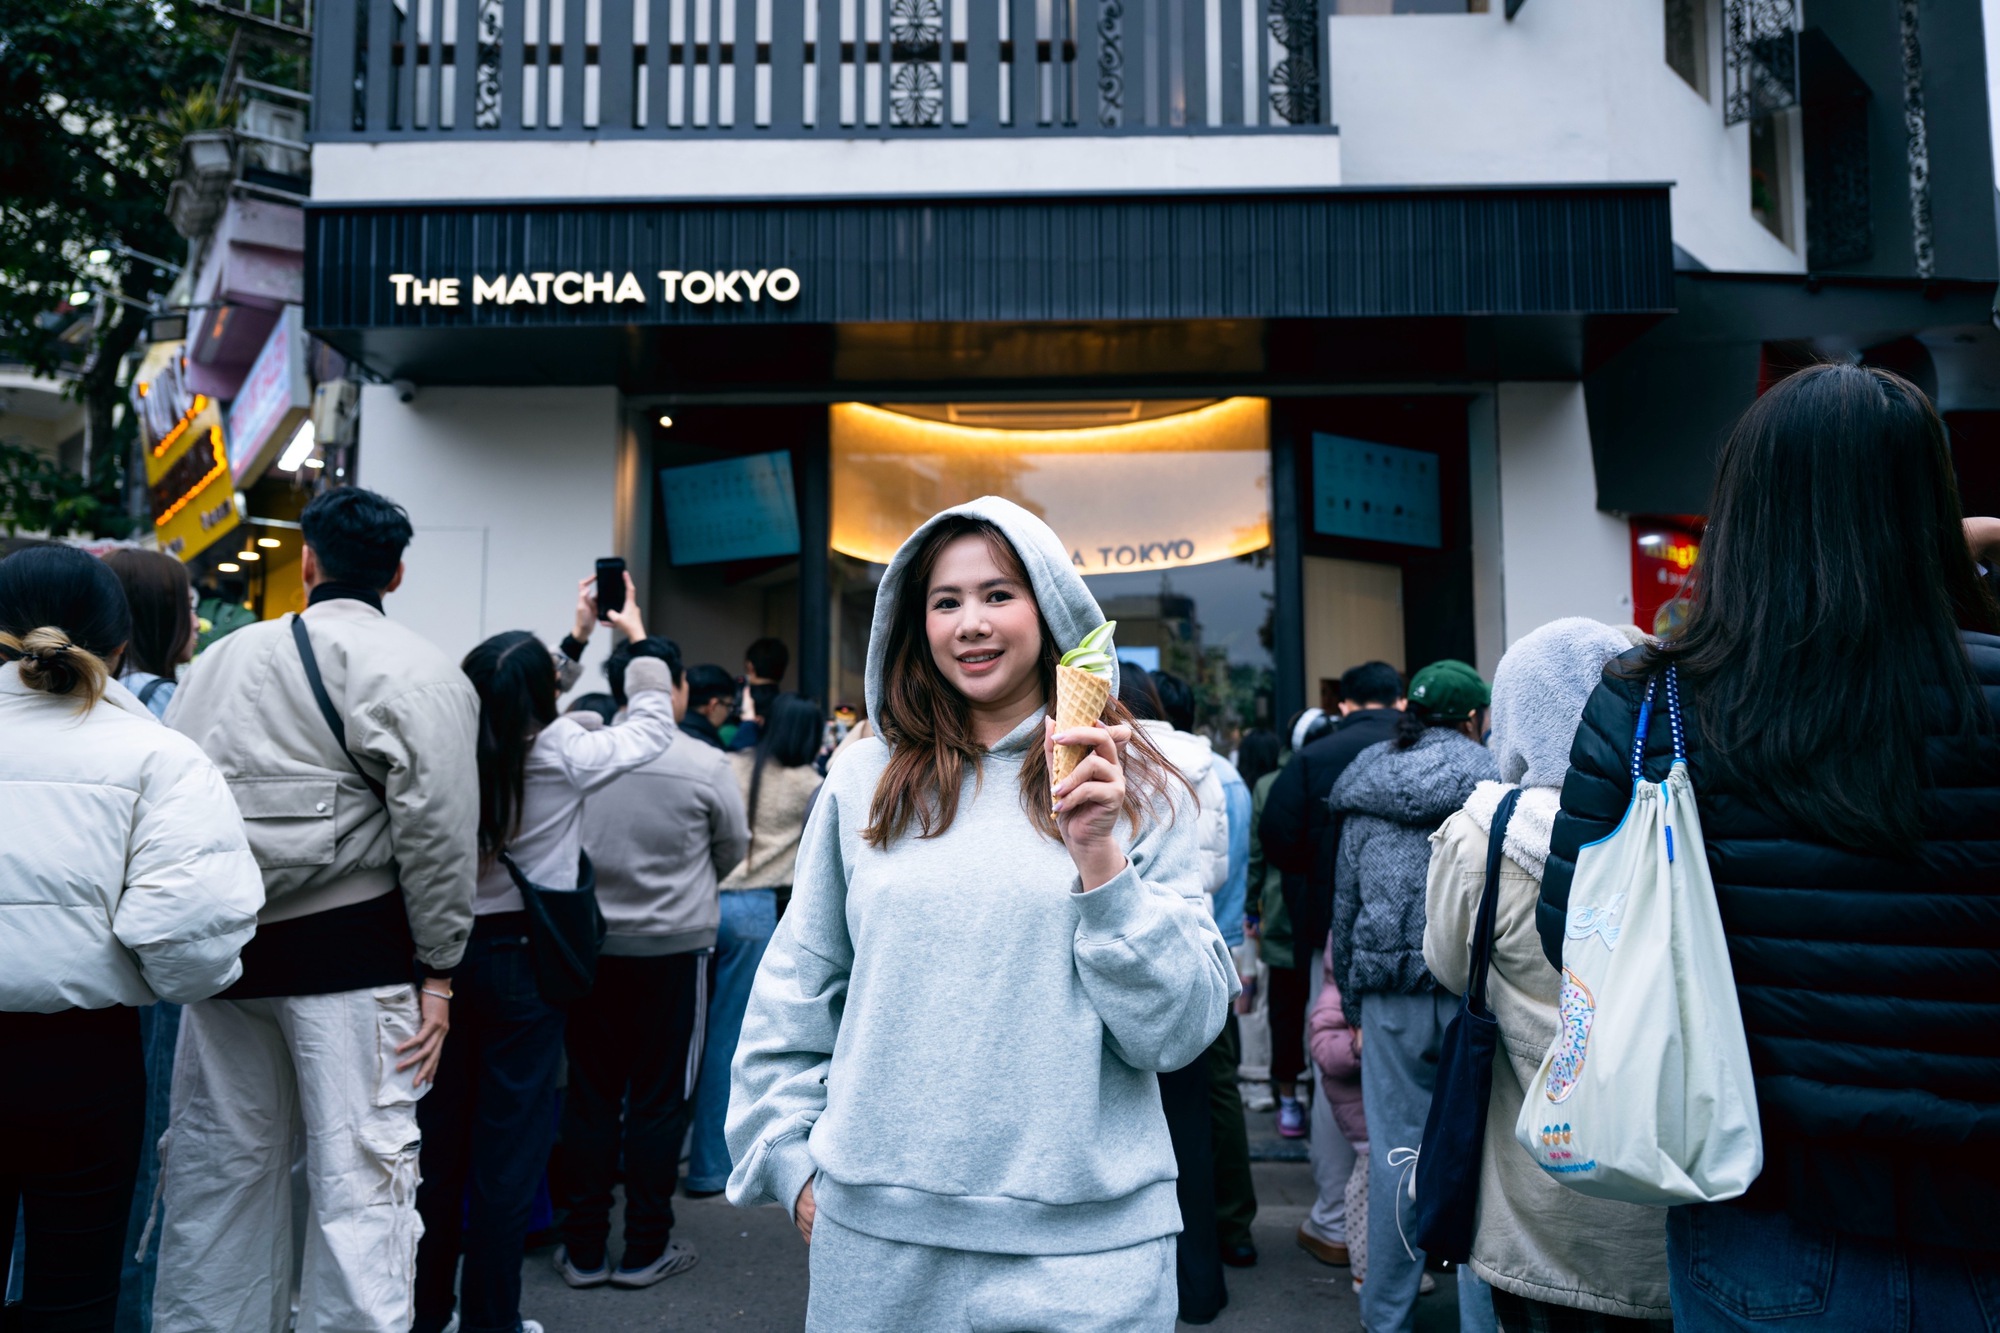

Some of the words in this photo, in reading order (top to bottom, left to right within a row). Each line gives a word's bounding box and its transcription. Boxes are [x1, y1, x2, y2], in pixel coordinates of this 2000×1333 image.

[472, 271, 646, 305] MATCHA
[657, 268, 801, 304] TOKYO
[1098, 539, 1195, 567] TOKYO
